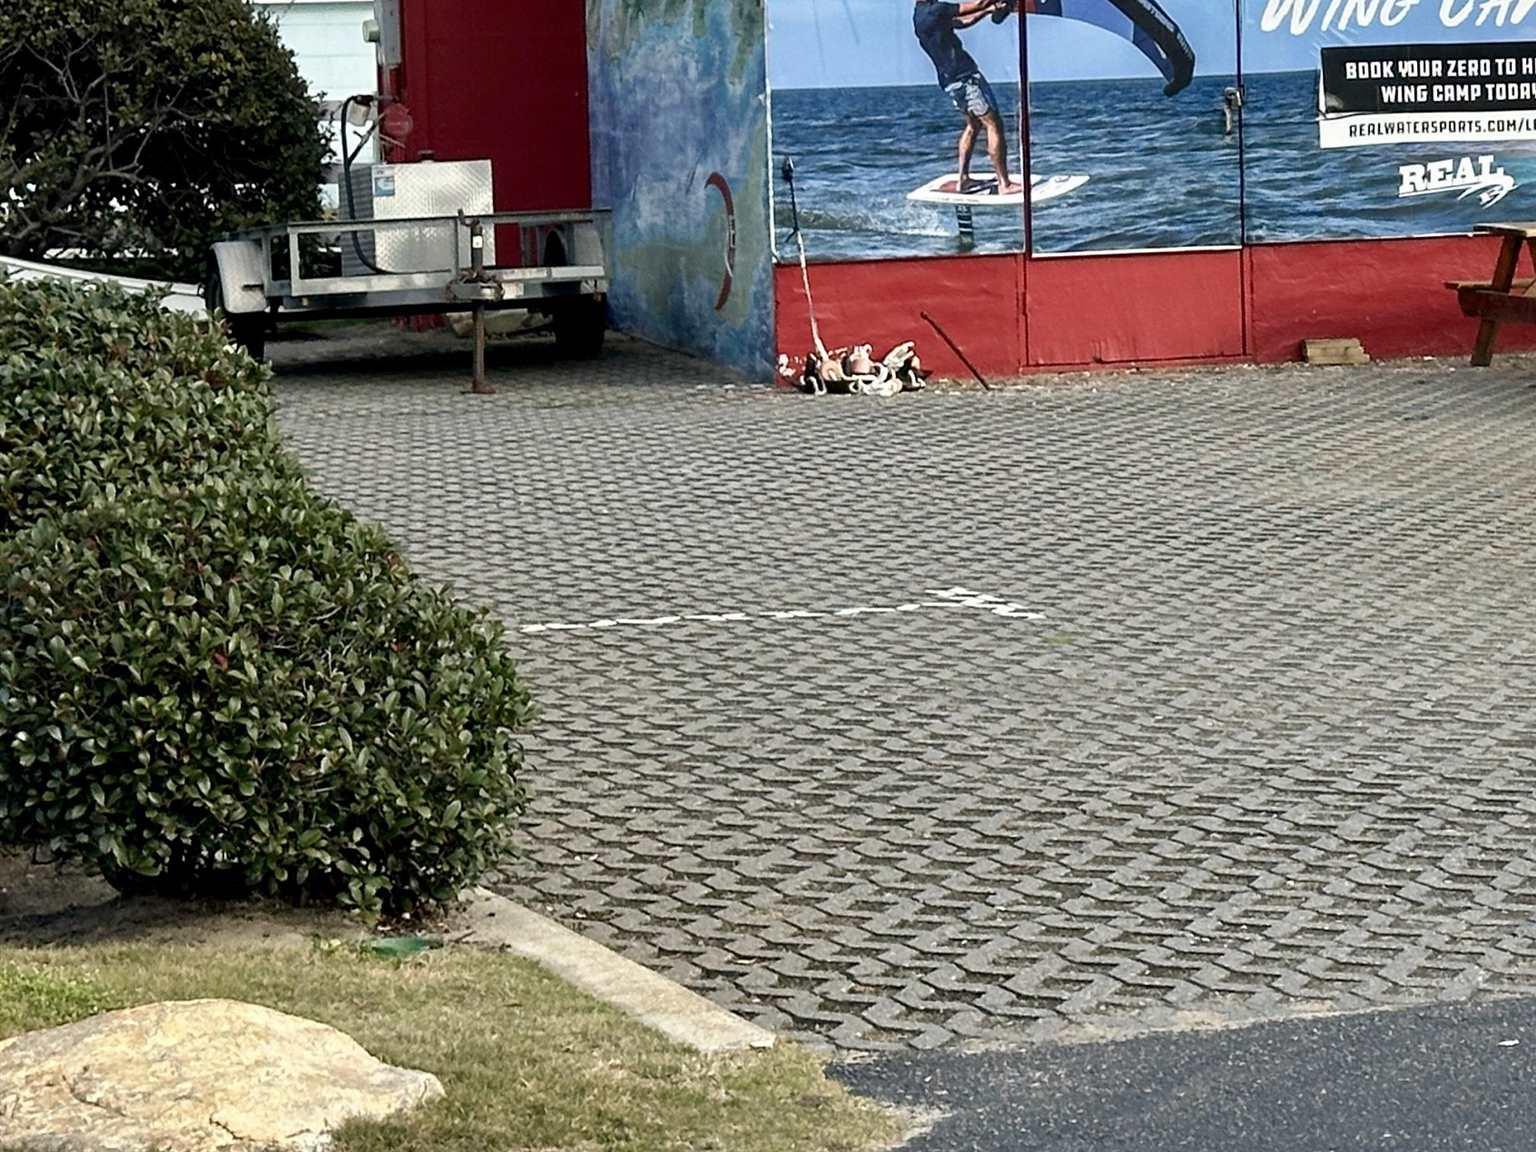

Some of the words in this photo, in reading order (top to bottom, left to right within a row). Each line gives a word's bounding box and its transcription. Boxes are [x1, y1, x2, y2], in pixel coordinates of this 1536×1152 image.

[1345, 60, 1394, 80] BOOK
[1398, 60, 1443, 79] YOUR
[1446, 58, 1491, 77] ZERO
[1495, 57, 1517, 76] TO
[1380, 84, 1428, 104] WING
[1432, 83, 1482, 102] CAMP
[1397, 154, 1506, 194] REAL
